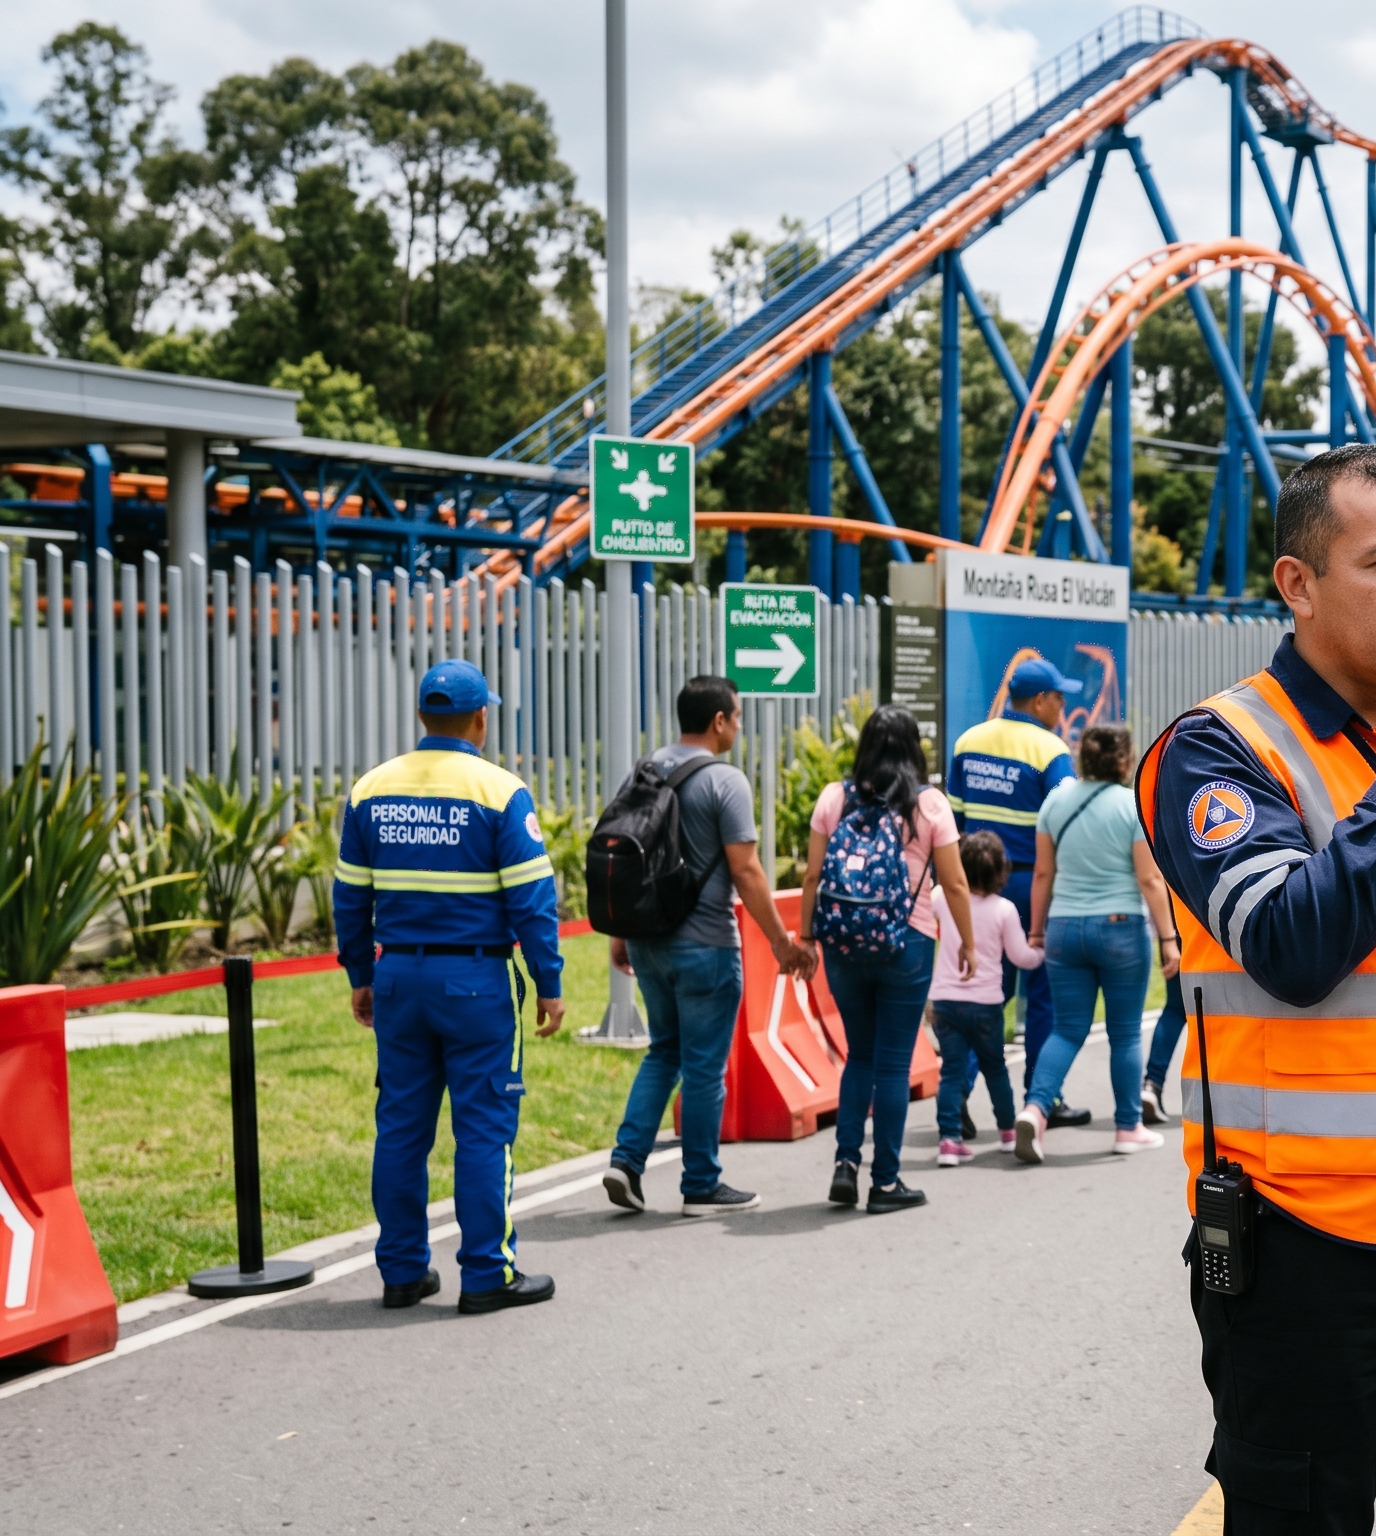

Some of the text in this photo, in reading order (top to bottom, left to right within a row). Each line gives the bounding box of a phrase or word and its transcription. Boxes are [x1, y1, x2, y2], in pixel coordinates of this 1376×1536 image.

[963, 568, 1116, 607] Montaña Rusa El Volcán
[371, 804, 470, 826] PERSONAL DE
[379, 825, 460, 845] SEGURIDAD
